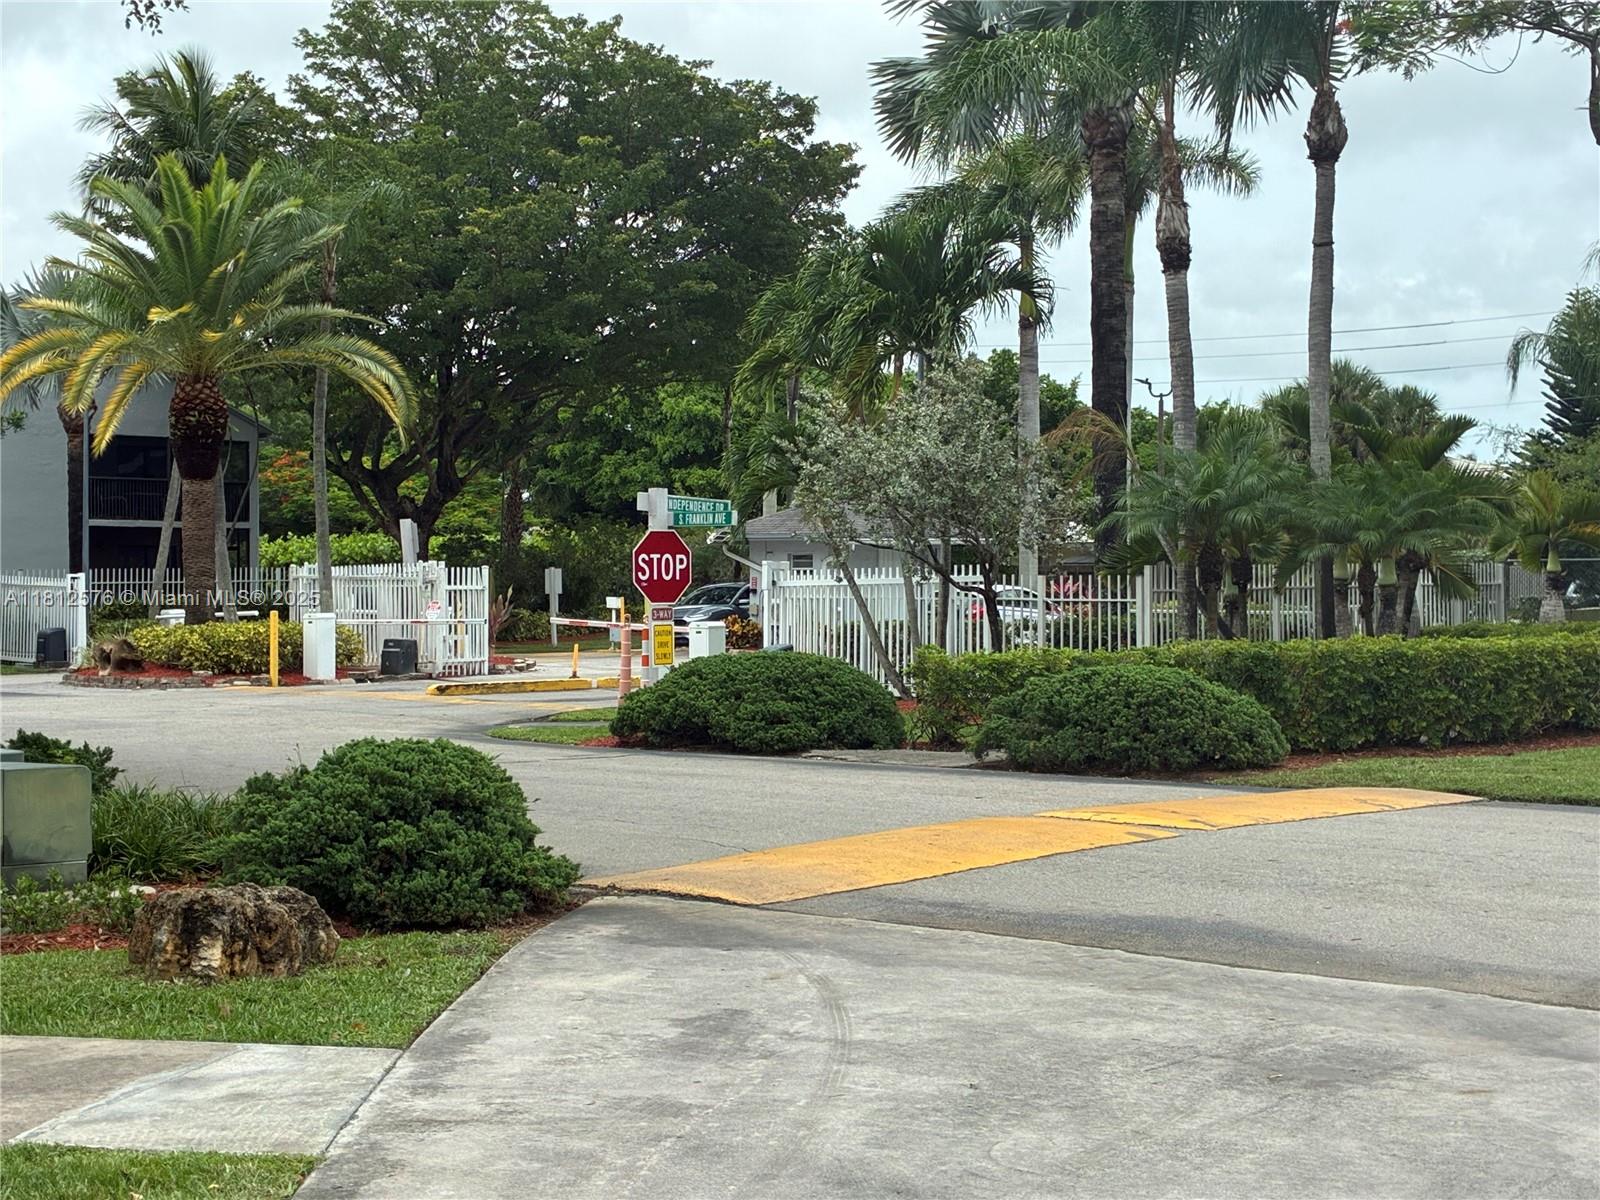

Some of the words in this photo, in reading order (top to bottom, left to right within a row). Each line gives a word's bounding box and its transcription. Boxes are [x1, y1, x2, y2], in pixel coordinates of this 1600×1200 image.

[668, 499, 714, 511] NDEPENDENCE
[685, 513, 713, 524] FRANKLIN
[714, 513, 726, 524] AVE
[637, 553, 688, 581] STOP
[653, 610, 672, 619] 3-WAY
